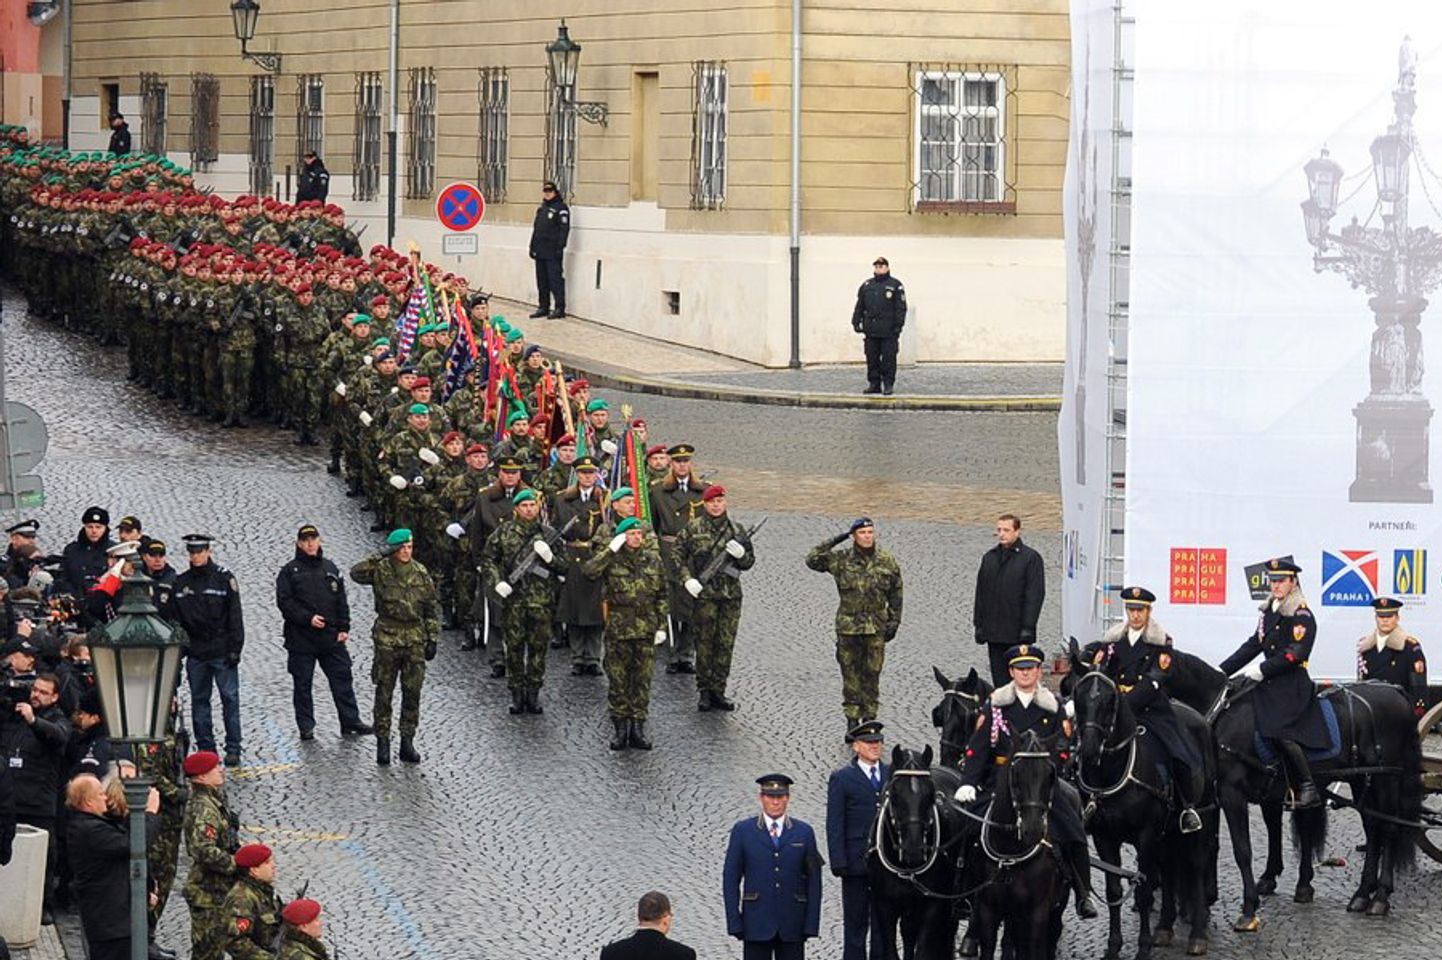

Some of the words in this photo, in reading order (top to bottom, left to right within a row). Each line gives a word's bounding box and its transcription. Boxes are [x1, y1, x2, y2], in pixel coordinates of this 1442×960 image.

[1174, 552, 1195, 561] PRA
[1200, 552, 1216, 561] HA
[1174, 564, 1195, 574] PRA
[1200, 564, 1223, 574] GUE
[1174, 577, 1195, 587] PRA
[1200, 577, 1216, 587] GA
[1174, 590, 1195, 599] PRA
[1200, 590, 1209, 599] G
[1330, 593, 1362, 601] PRAHA
